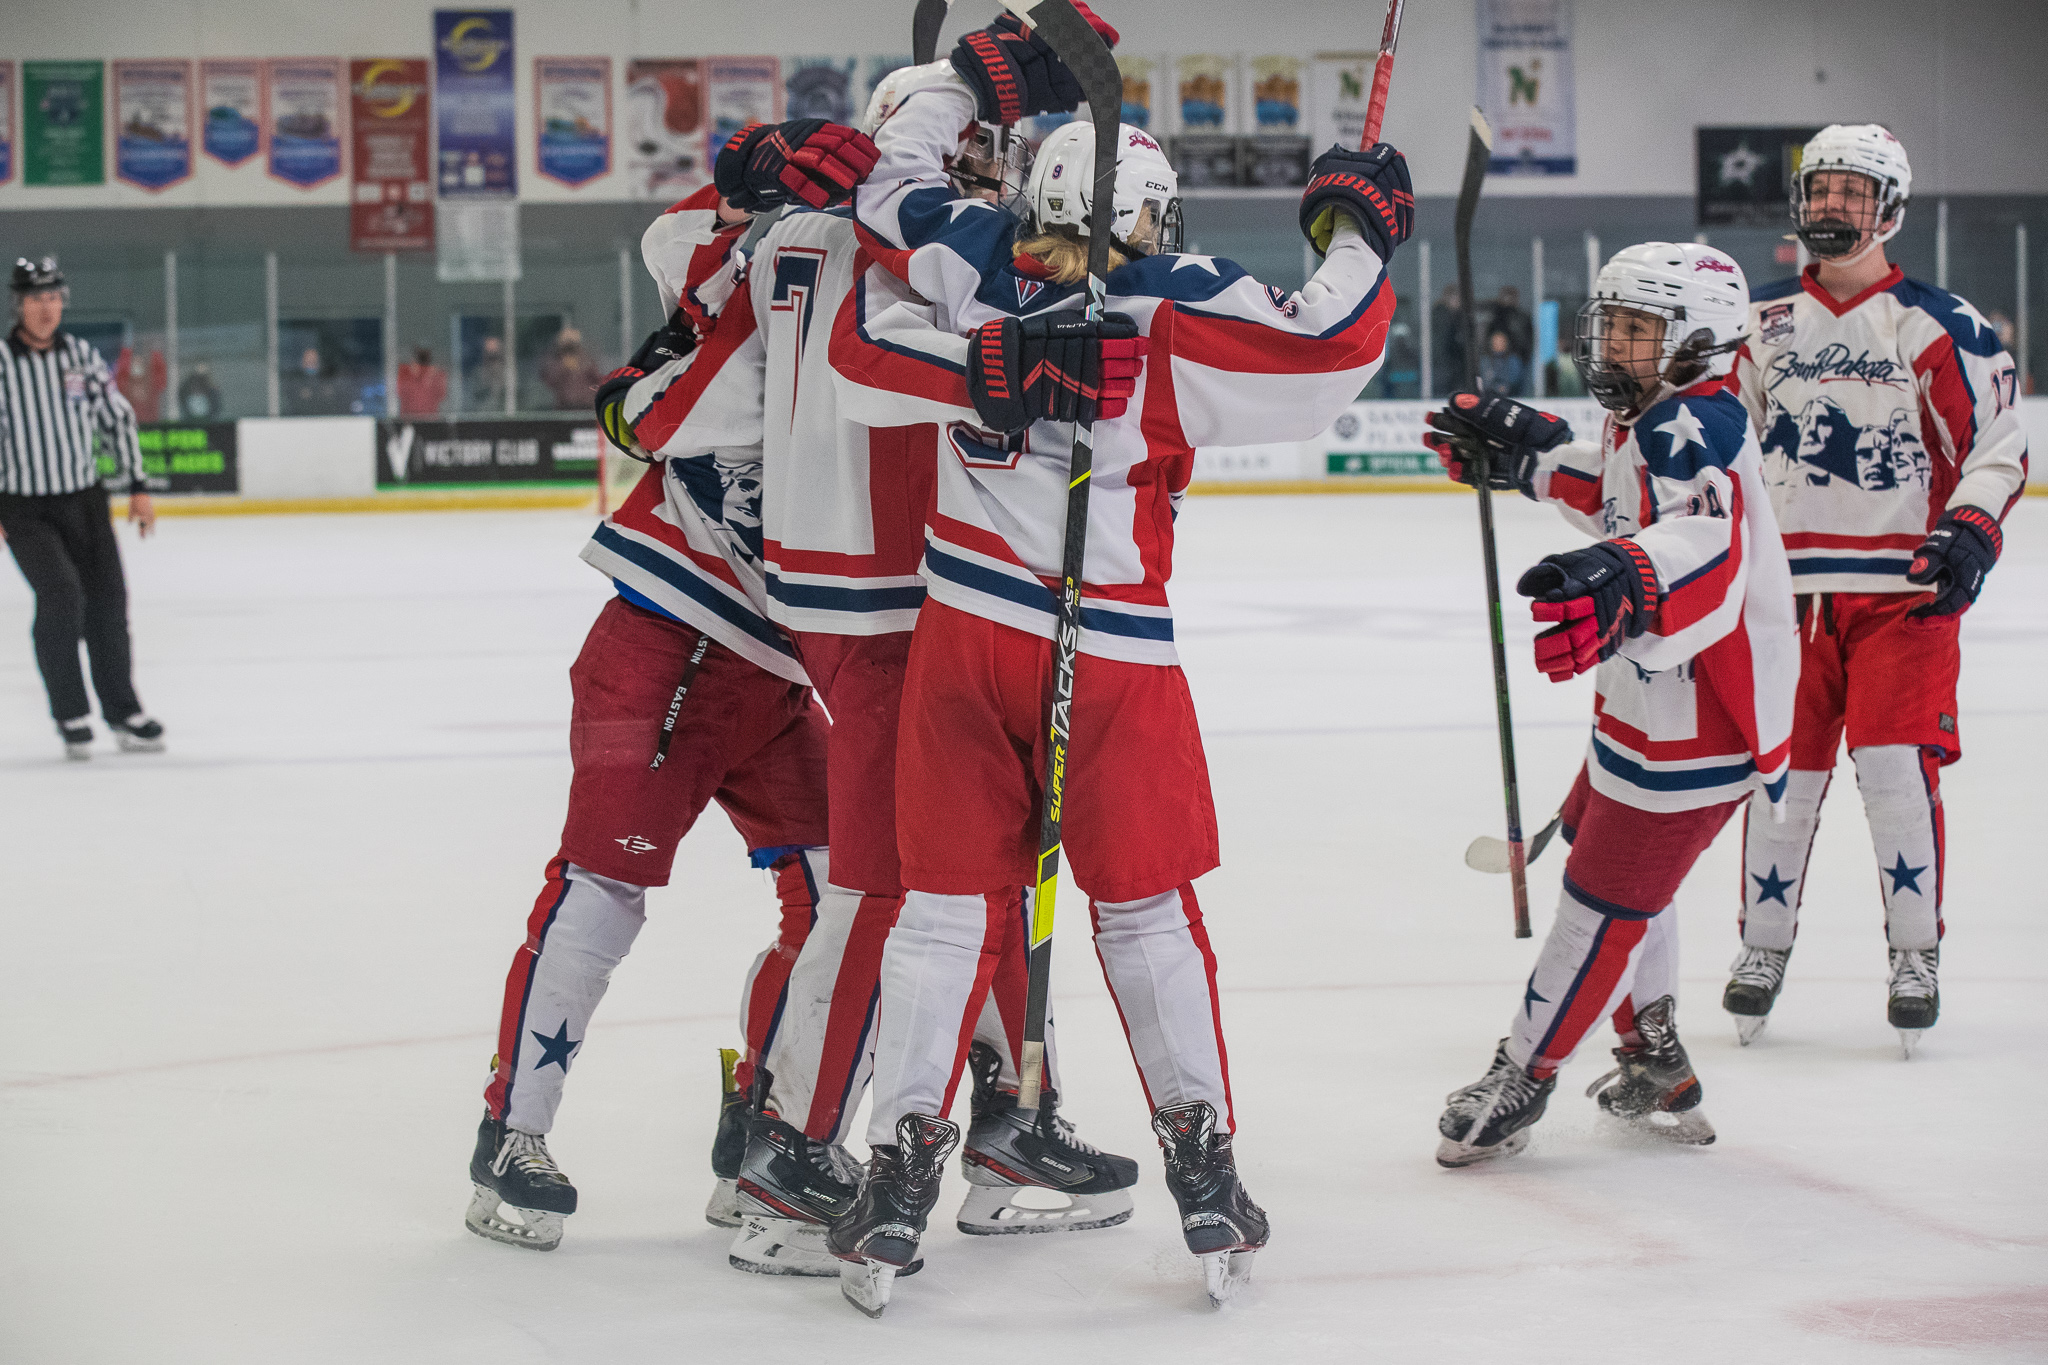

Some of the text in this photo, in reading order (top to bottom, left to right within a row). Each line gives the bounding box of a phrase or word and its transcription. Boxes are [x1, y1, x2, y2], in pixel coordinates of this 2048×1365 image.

[1051, 163, 1064, 180] 9
[1145, 180, 1169, 193] CCM
[1990, 365, 2016, 420] 17
[1050, 620, 1077, 742] TACKS
[663, 686, 687, 733] EASTON
[1050, 743, 1066, 823] SUPER
[1040, 1156, 1073, 1173] BAUER
[803, 1186, 837, 1205] BAUER
[1186, 1219, 1220, 1232] BAUER
